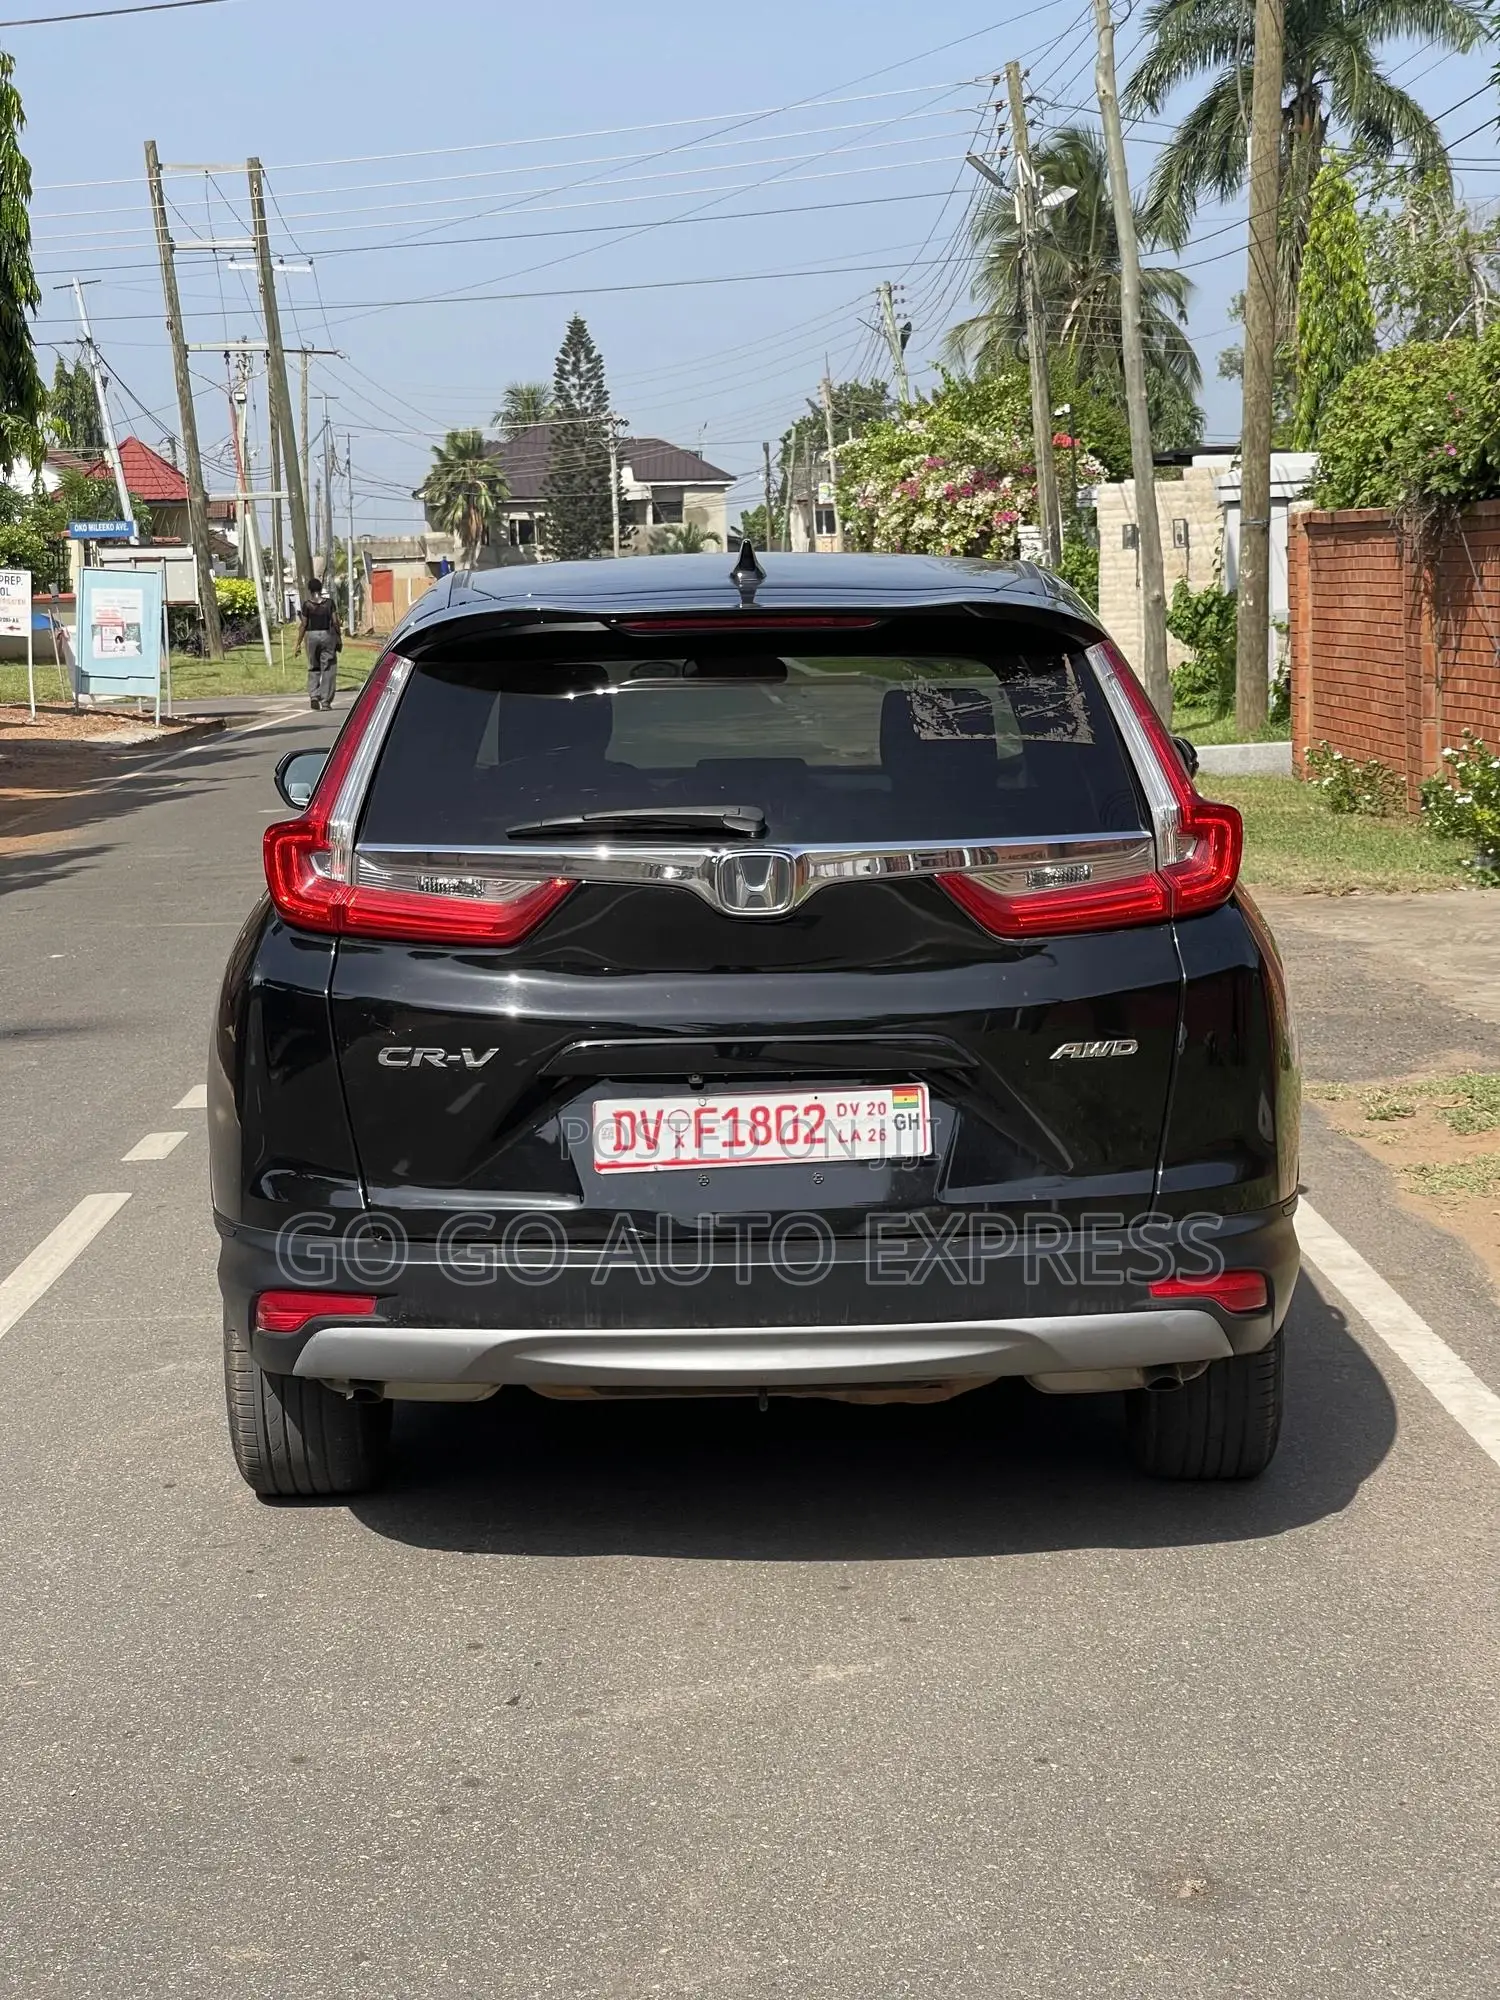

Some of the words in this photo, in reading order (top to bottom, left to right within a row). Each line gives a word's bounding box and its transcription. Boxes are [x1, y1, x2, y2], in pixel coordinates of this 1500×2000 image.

[74, 523, 87, 532] OKO
[115, 522, 129, 531] AVE.
[378, 1047, 499, 1068] CR-V
[1049, 1039, 1138, 1060] AWD
[837, 1102, 860, 1117] DV
[867, 1101, 886, 1116] 20
[613, 1109, 664, 1151] DV
[893, 1113, 920, 1131] GH
[838, 1130, 861, 1143] LA
[868, 1128, 886, 1142] 26
